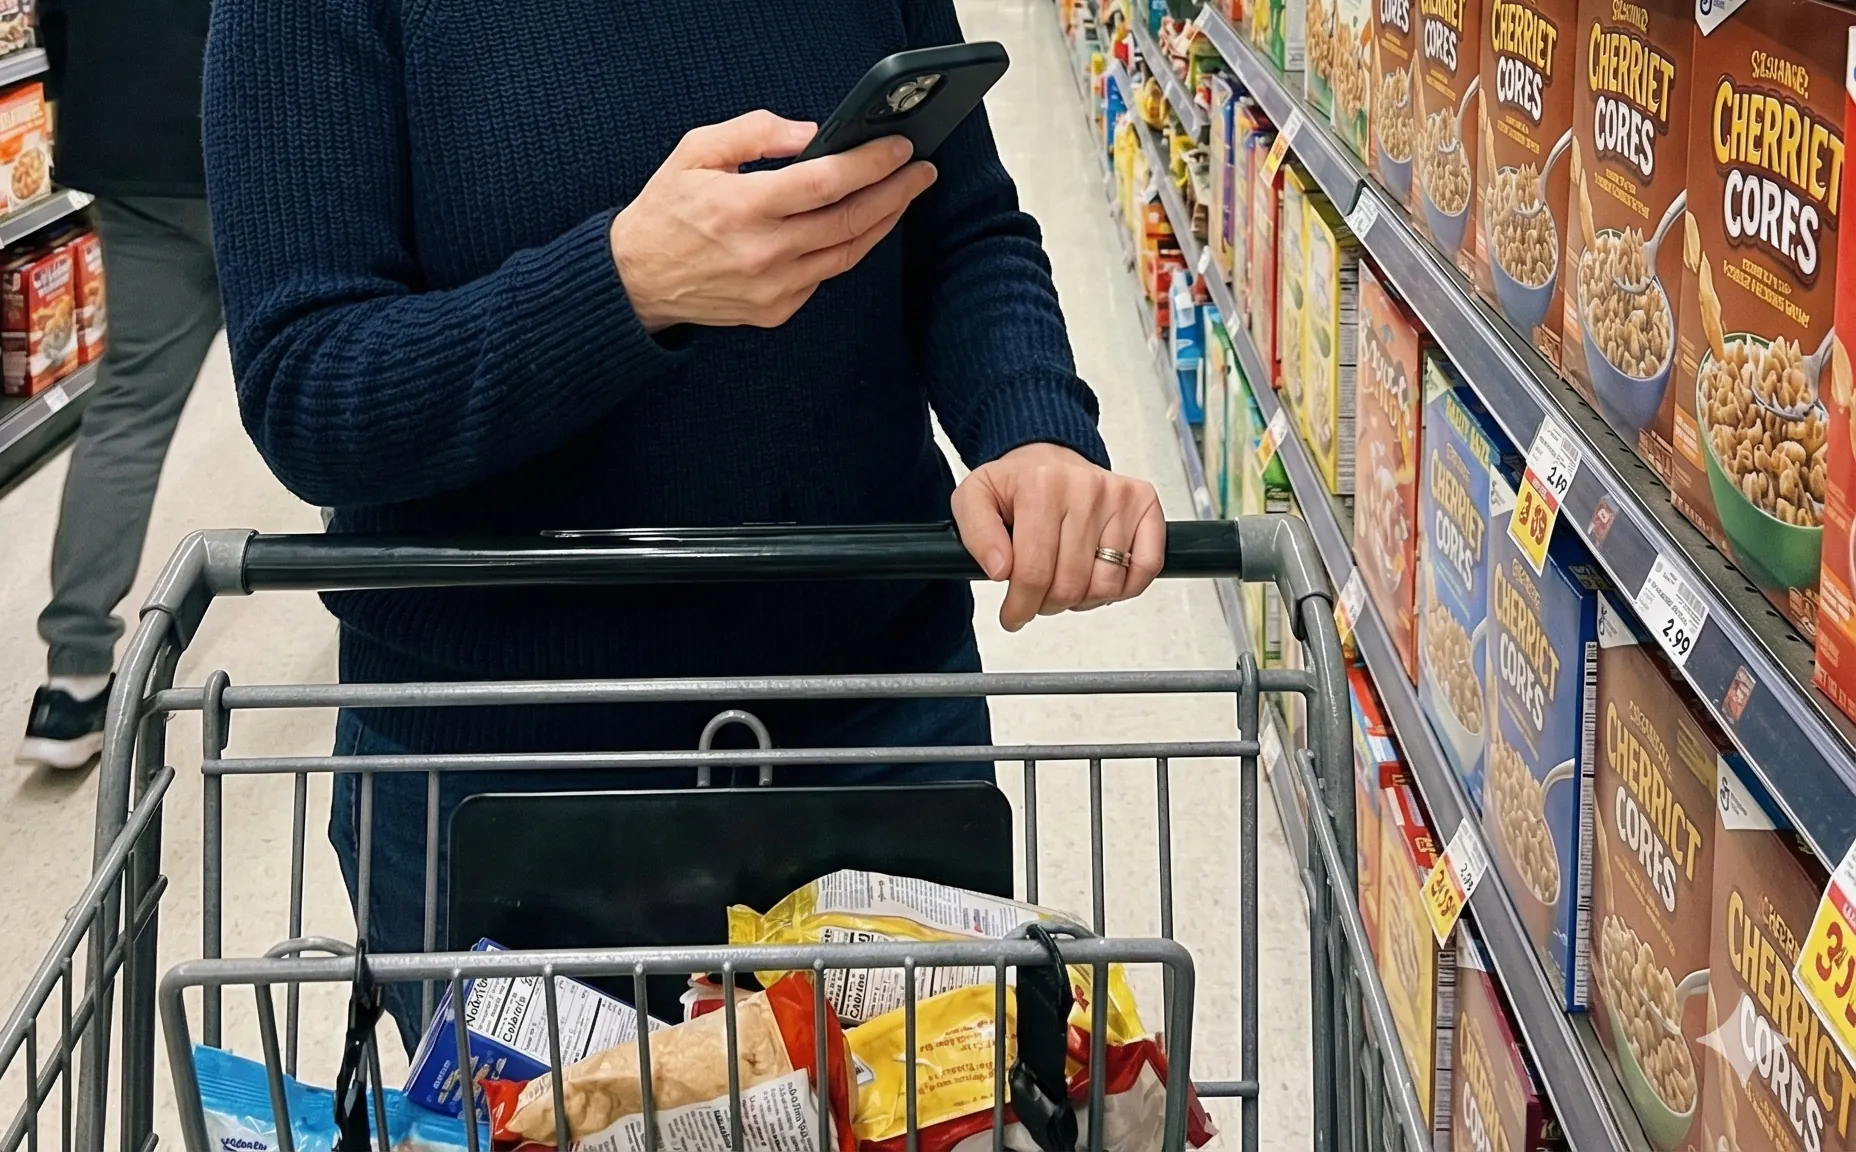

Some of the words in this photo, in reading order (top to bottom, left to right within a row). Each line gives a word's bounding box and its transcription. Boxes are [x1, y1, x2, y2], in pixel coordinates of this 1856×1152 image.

[1424, 18, 1457, 71] CORES
[1588, 22, 1675, 123] CHERRIET
[1497, 55, 1544, 121] CORES
[1594, 95, 1656, 176] CORES
[1713, 80, 1845, 216] CHERRIET
[1662, 618, 1690, 655] 2.99
